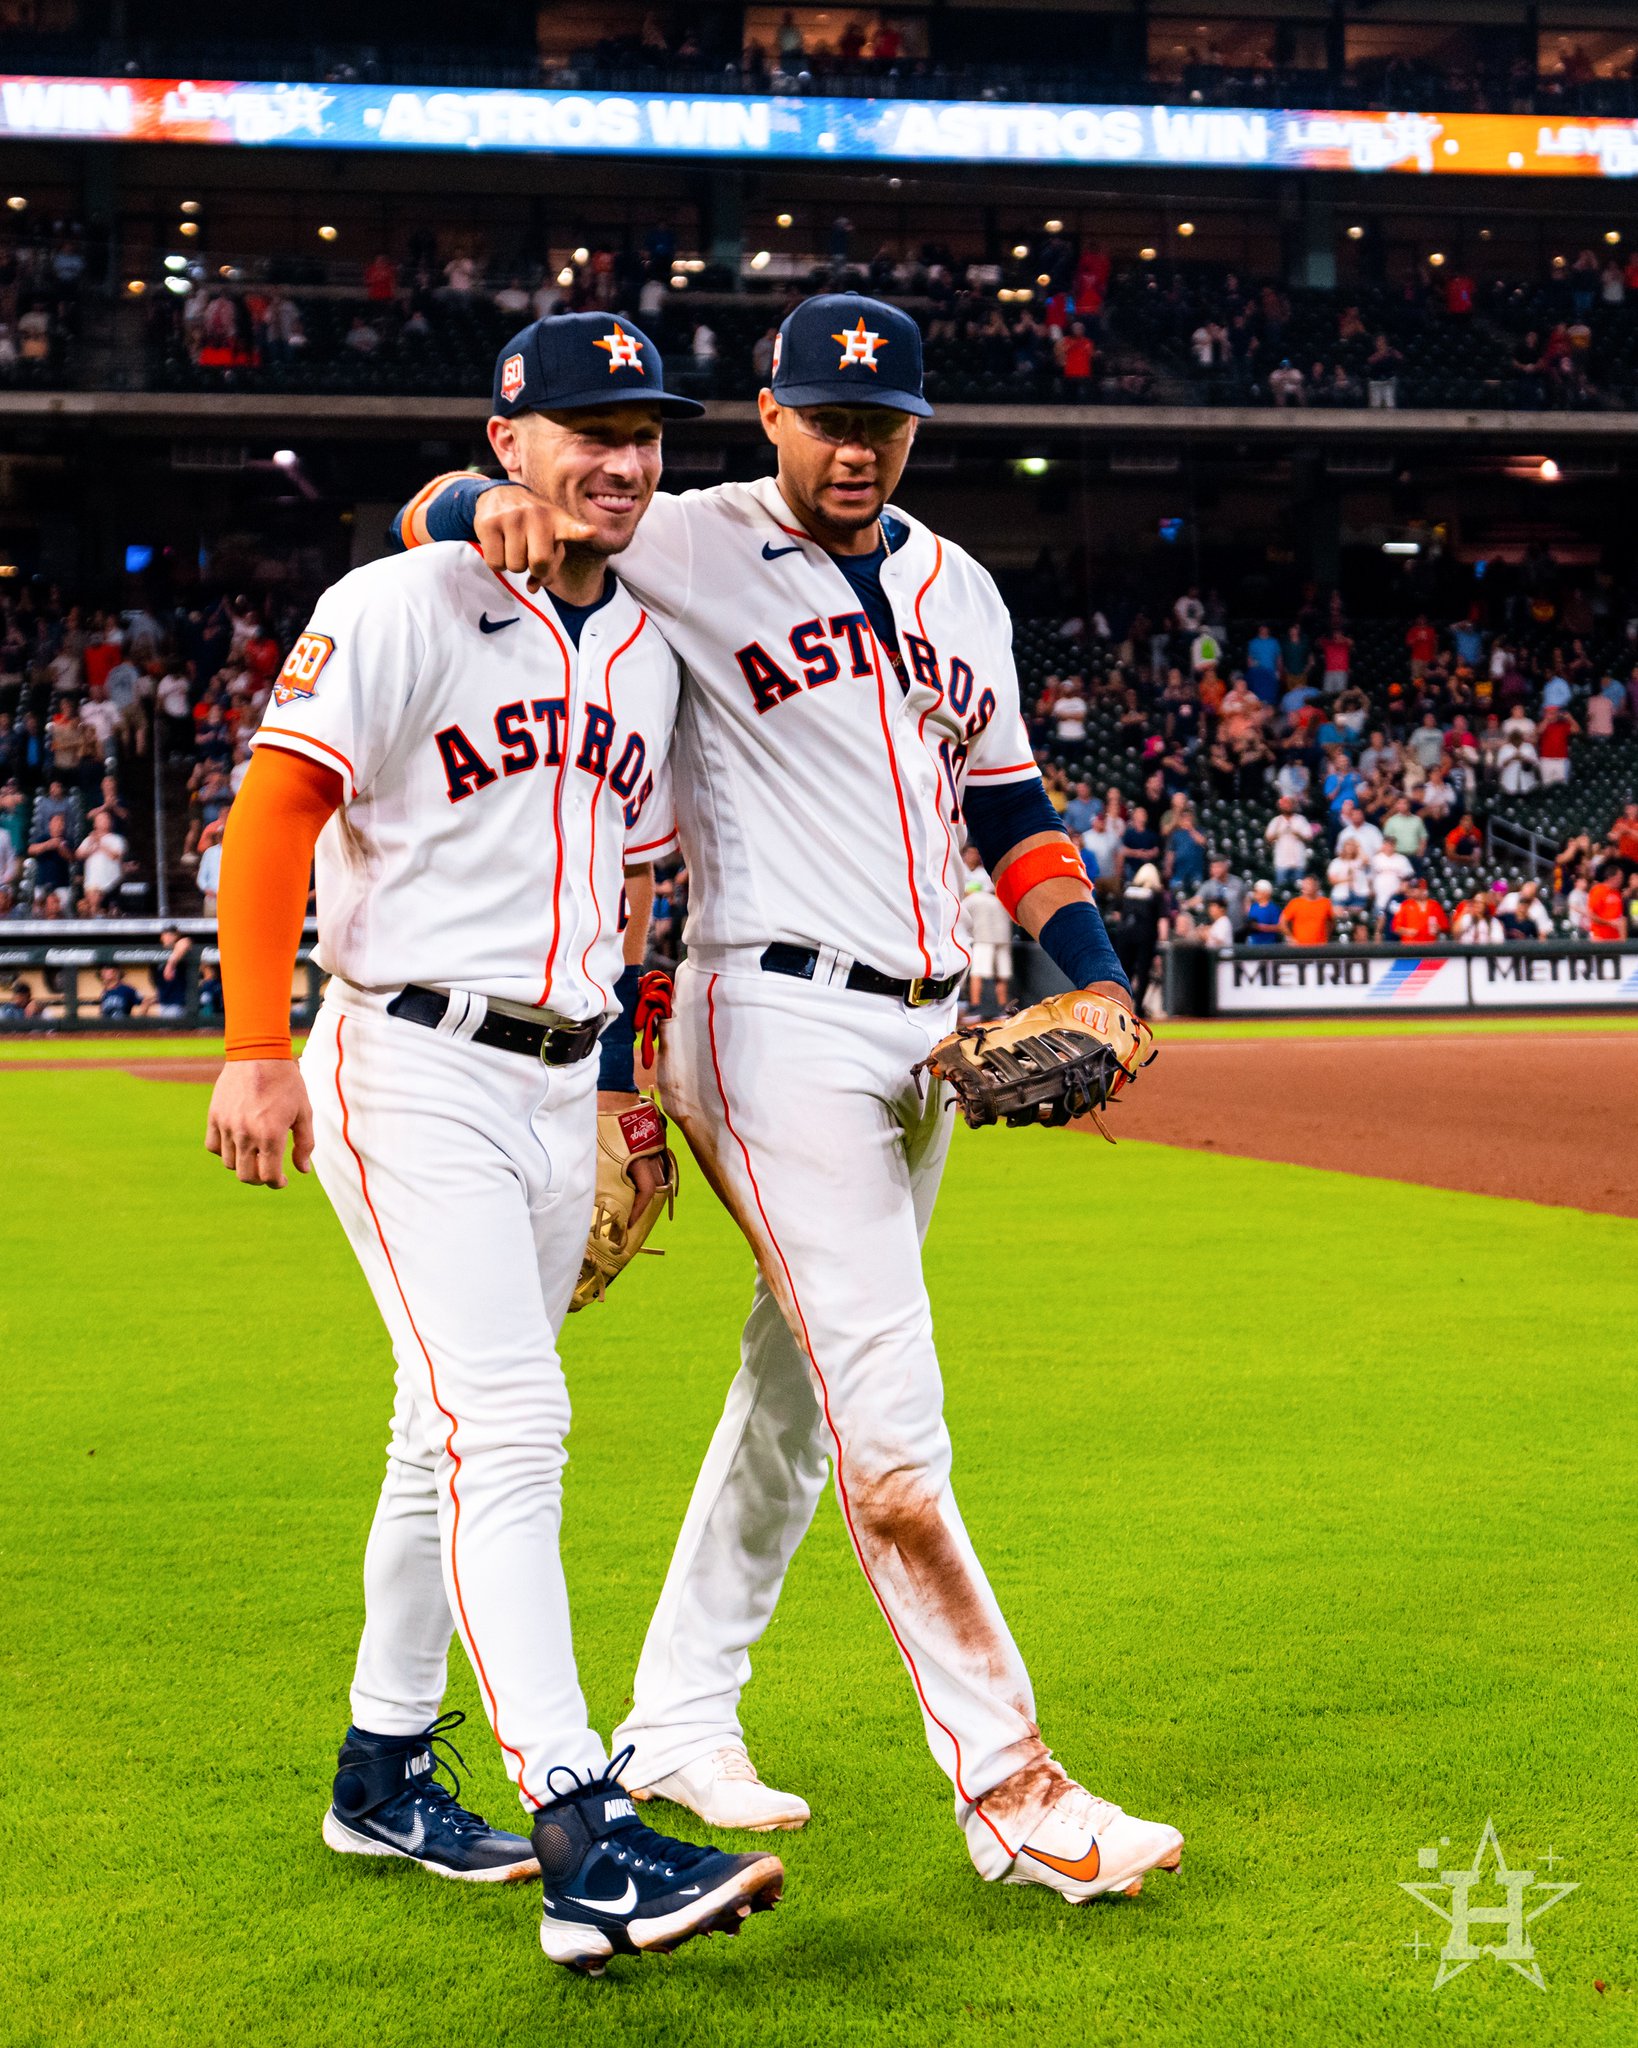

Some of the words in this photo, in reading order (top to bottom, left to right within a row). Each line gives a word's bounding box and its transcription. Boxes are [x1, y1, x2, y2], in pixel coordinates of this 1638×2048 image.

[3, 82, 133, 132] WIN
[379, 93, 640, 145] ASTROS
[647, 101, 769, 149] WIN
[894, 107, 1142, 157] ASTROS
[1152, 112, 1266, 158] WIN
[1286, 120, 1386, 147] LEVEL
[604, 334, 643, 367] H
[841, 329, 879, 364] H
[505, 359, 521, 386] 60
[284, 637, 328, 680] 60
[734, 611, 996, 742] ASTROS
[434, 697, 655, 830] ASTROS
[1233, 959, 1370, 987] METRO
[1488, 954, 1621, 982] METRO
[405, 1751, 430, 1779] NIKE
[604, 1798, 637, 1822] NIKE
